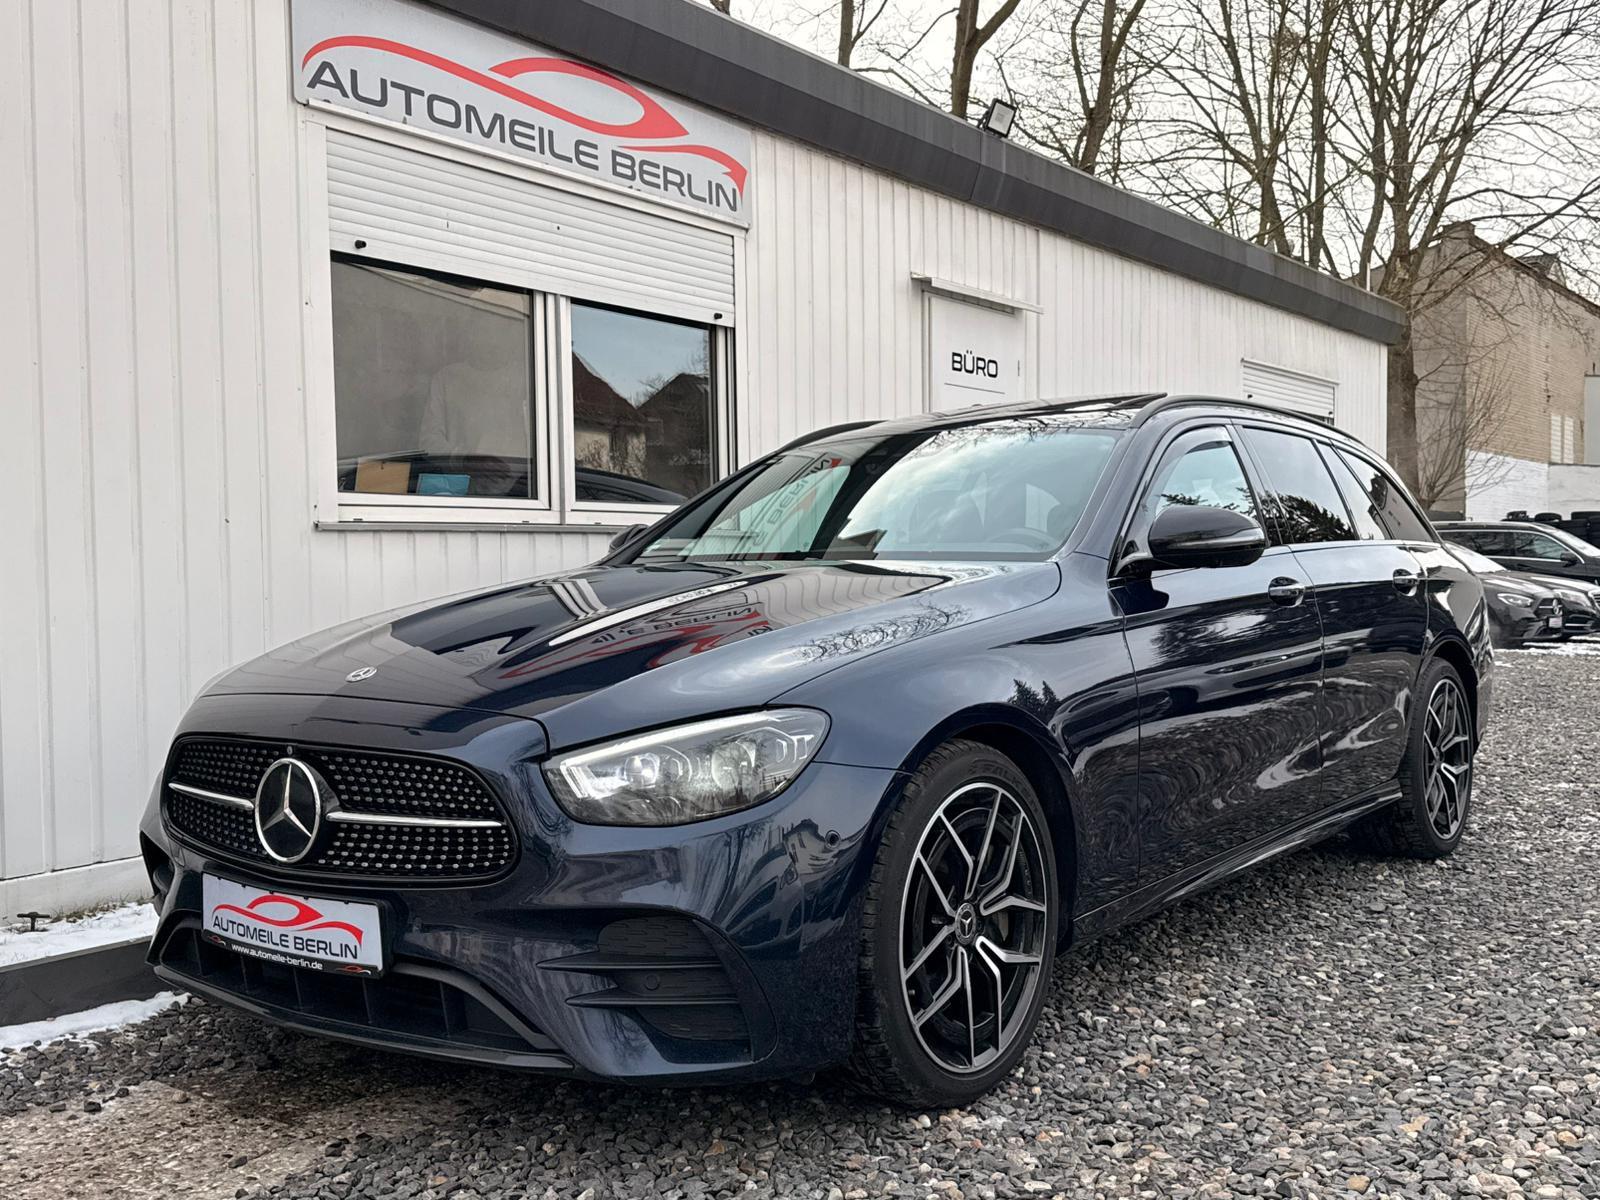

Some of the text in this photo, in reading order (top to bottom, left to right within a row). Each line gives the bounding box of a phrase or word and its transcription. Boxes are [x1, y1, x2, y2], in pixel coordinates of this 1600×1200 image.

[306, 60, 737, 212] AUTOMEILE BERLIN
[951, 349, 999, 379] BÜRO
[212, 914, 358, 960] AUTOMEILE BERLIN
[231, 943, 323, 970] www.automeile-berlin.de
